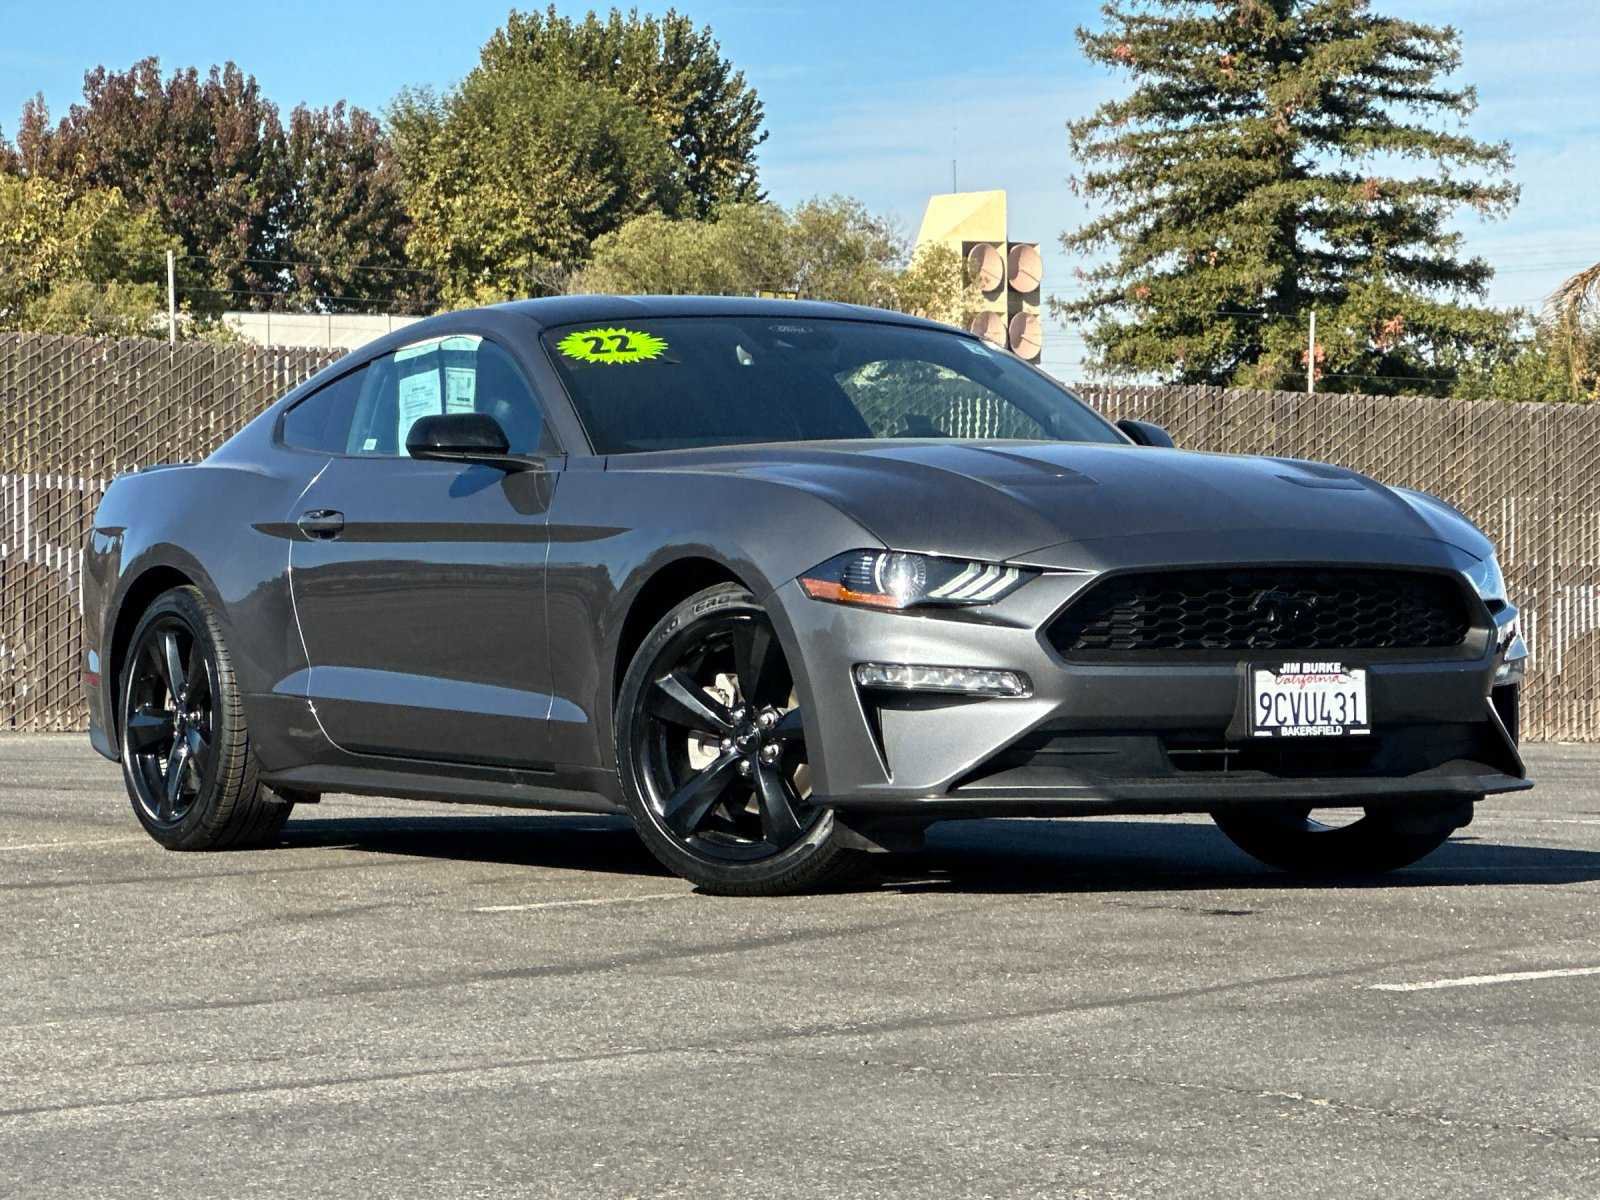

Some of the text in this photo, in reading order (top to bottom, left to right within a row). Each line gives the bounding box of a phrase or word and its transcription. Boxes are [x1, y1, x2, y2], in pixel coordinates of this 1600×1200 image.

[581, 334, 637, 354] 22
[1280, 662, 1341, 674] JIM BURKE
[1275, 674, 1347, 689] California
[1259, 692, 1362, 725] 9CVU431
[1281, 725, 1343, 736] BAKERSFIELD
